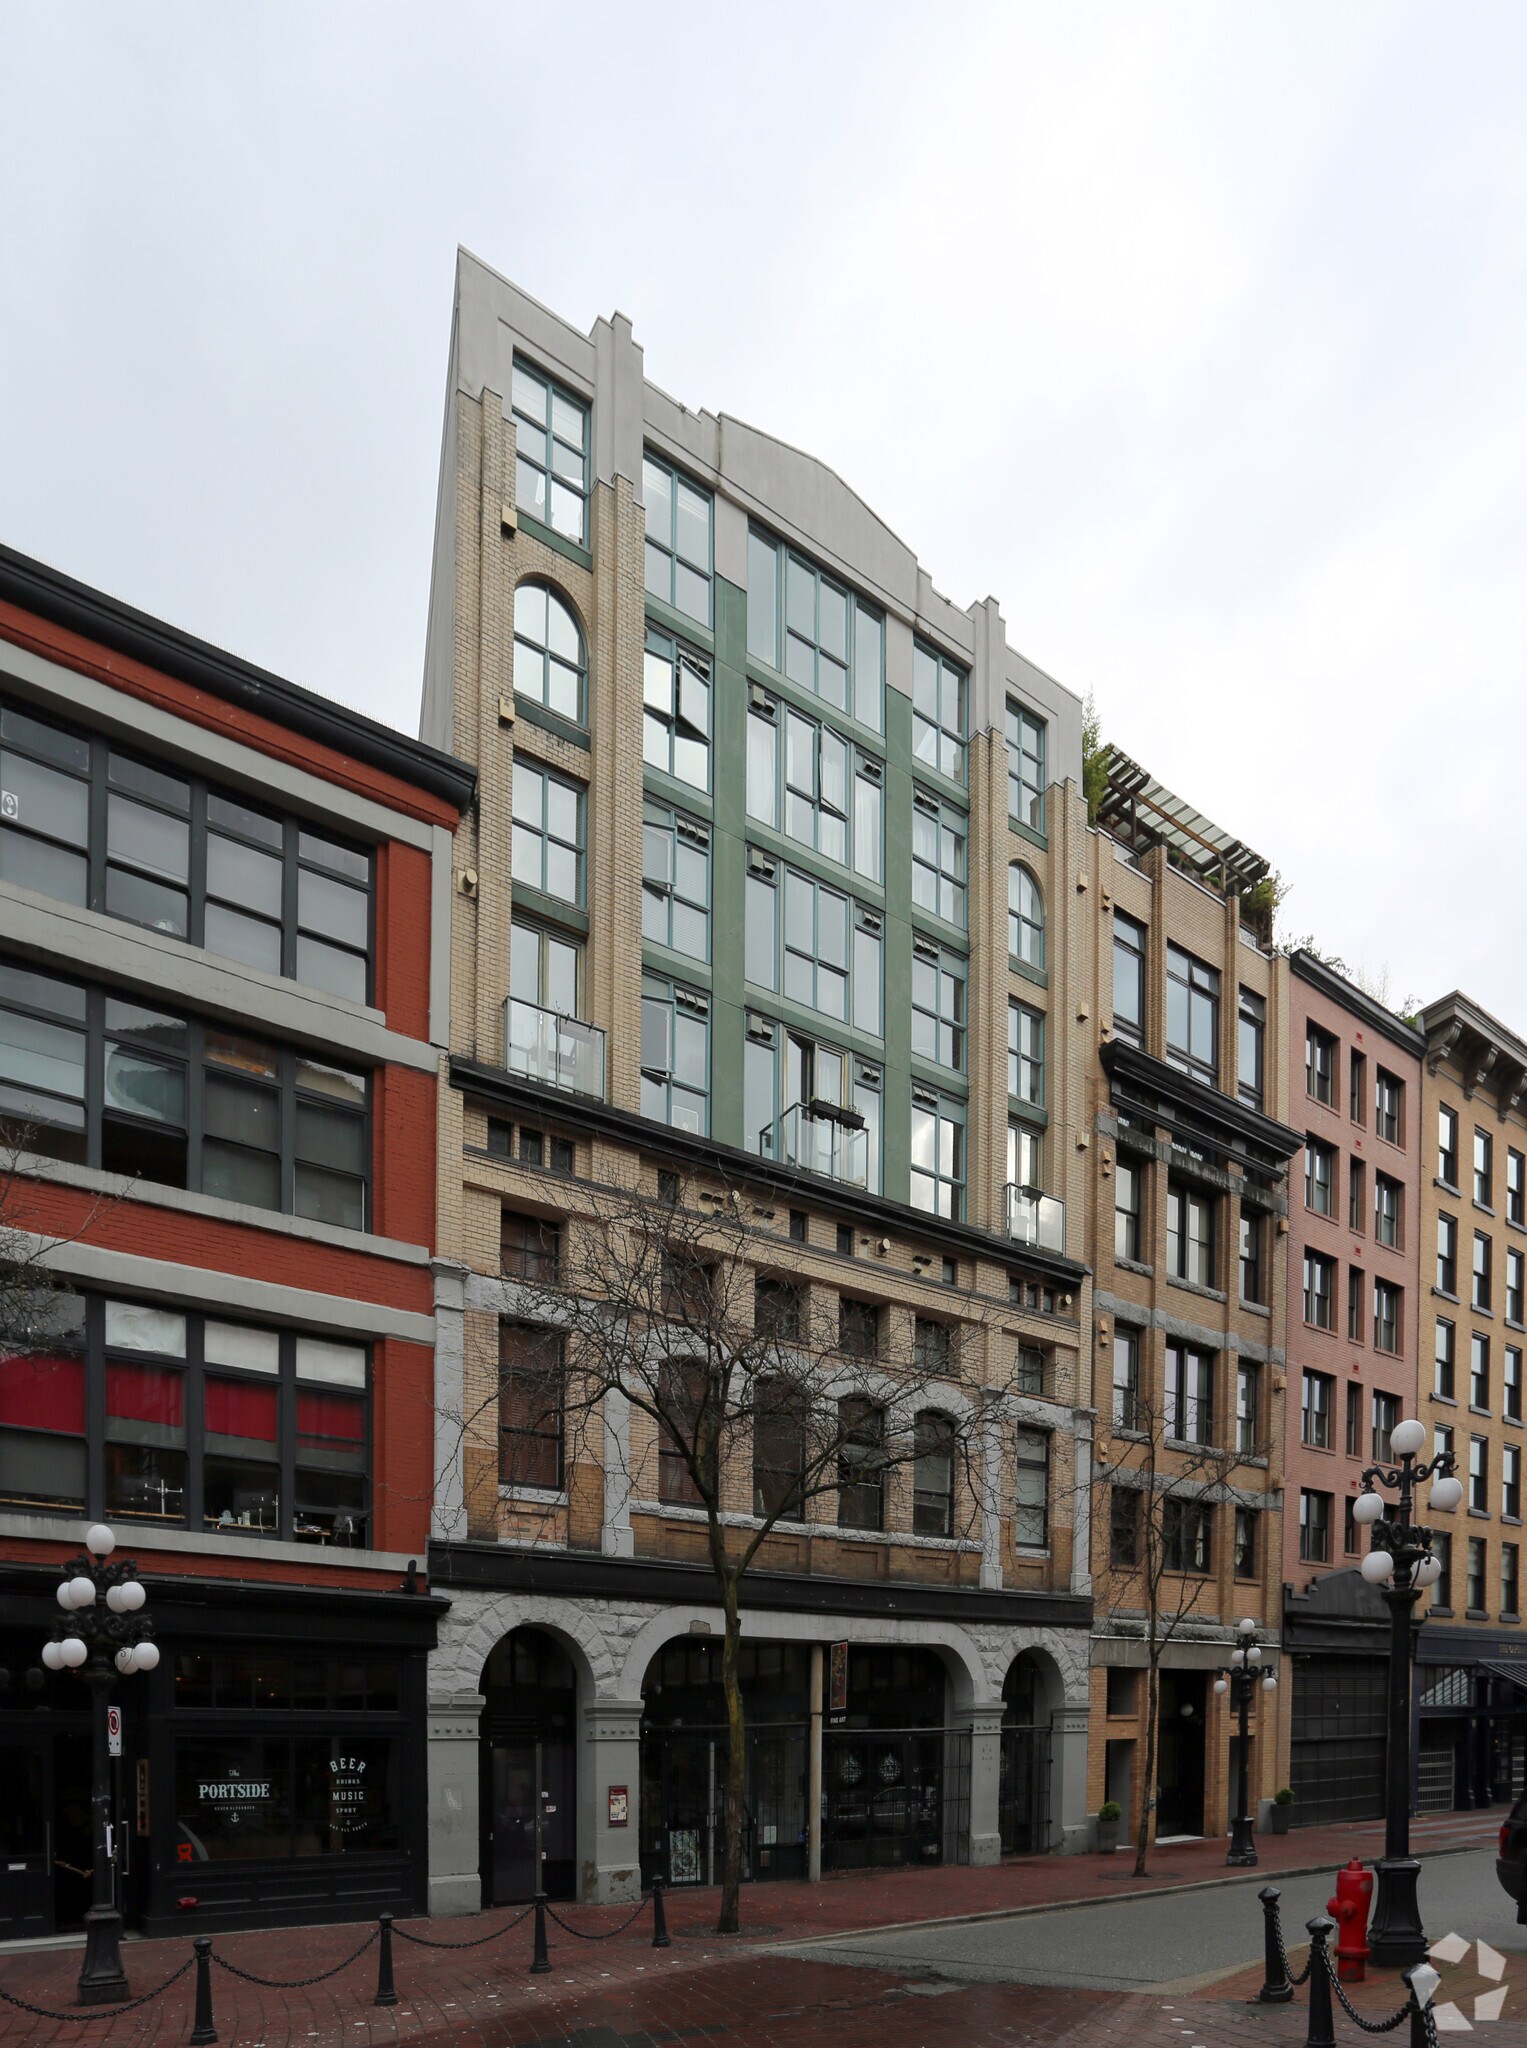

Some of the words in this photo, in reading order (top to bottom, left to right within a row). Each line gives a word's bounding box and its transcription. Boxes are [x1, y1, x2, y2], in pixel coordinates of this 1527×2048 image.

[329, 1757, 367, 1774] BEER
[228, 1769, 240, 1777] The
[198, 1783, 270, 1799] PORTSIDE
[332, 1791, 364, 1801] MUSIC
